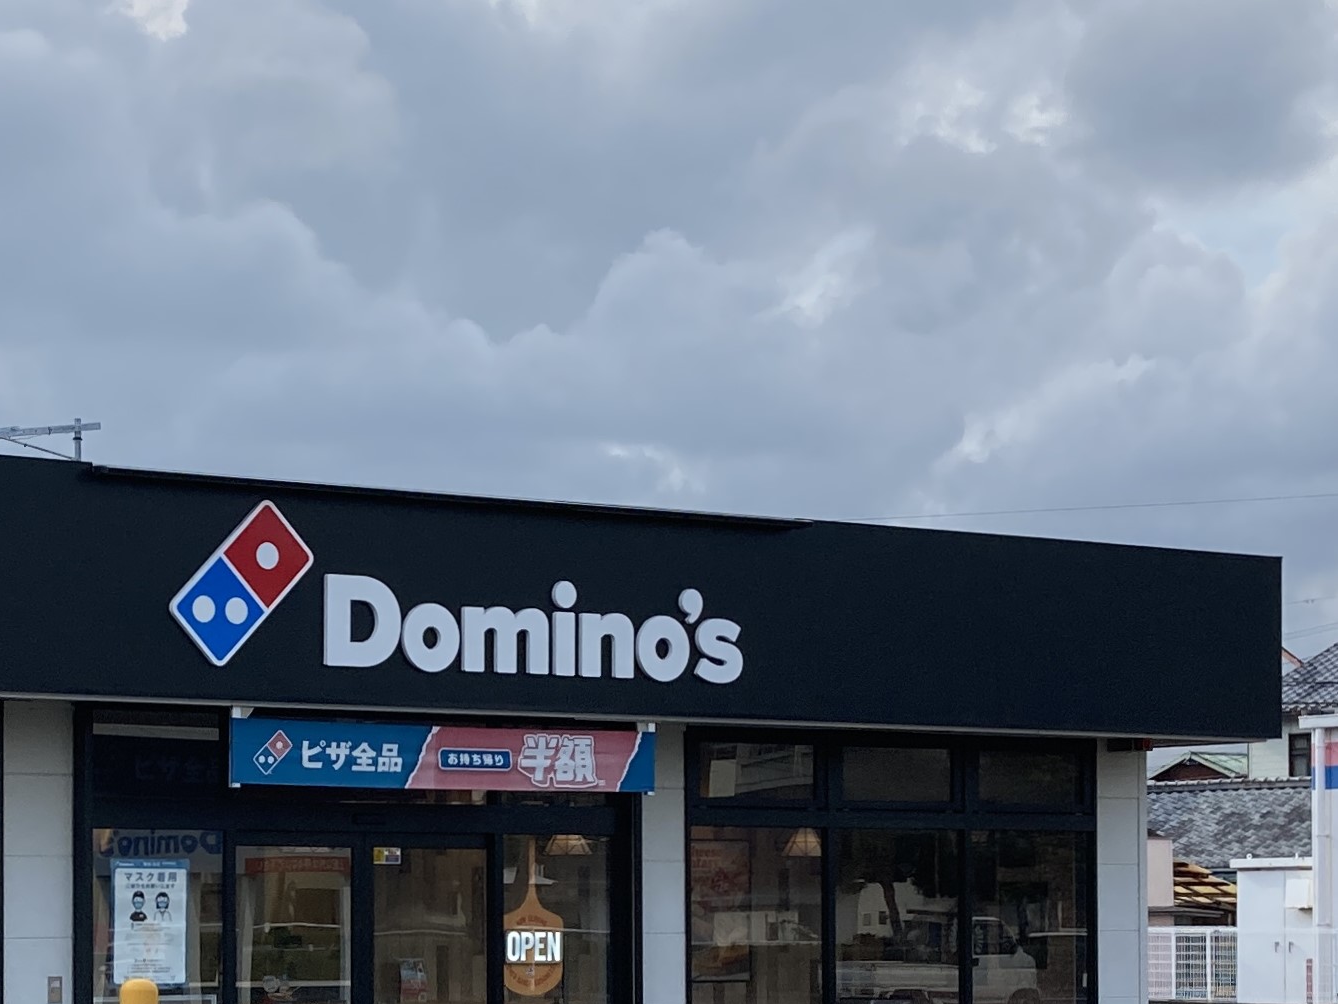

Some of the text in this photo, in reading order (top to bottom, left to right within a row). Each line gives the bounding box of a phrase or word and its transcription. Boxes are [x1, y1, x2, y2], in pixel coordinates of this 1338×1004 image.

[323, 573, 744, 685] Domino's
[301, 734, 598, 789] ピザ全品 お持ち帰り 半額
[124, 872, 178, 883] マスク着用
[507, 931, 561, 962] OPEN
